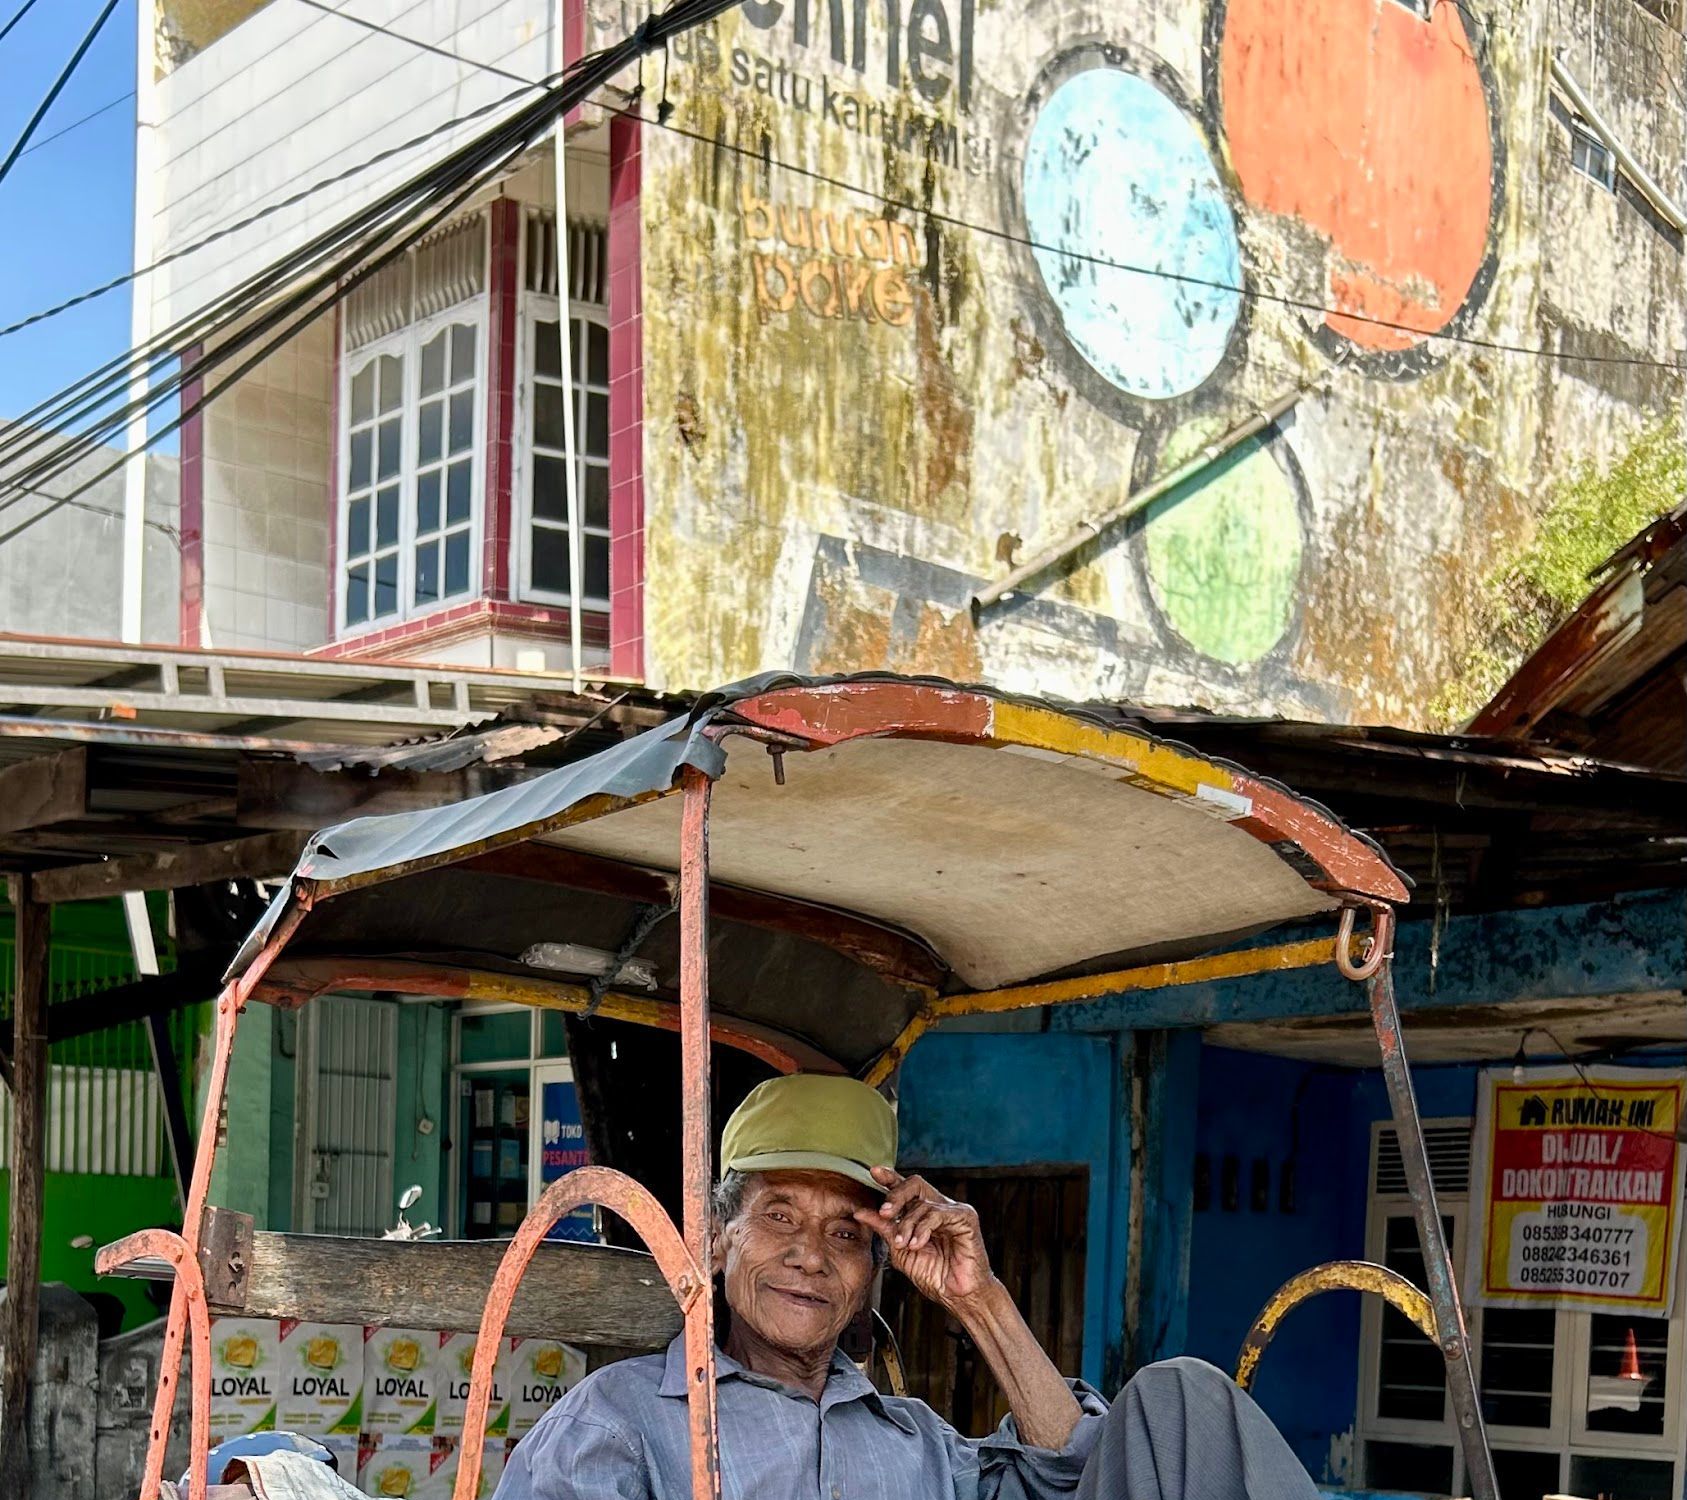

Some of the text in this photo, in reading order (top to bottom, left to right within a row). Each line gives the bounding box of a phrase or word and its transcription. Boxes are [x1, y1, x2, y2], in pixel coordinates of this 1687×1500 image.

[730, 47, 811, 114] satu
[742, 183, 920, 267] buruan
[752, 252, 914, 327] pake
[1551, 1097, 1656, 1127] RUMAH INI
[561, 1124, 582, 1139] TOKO
[1547, 1203, 1611, 1220] HUBUNGI
[212, 1376, 271, 1397] LOYAL
[293, 1377, 350, 1397] LOYAL
[376, 1378, 429, 1398] LOYAL
[449, 1382, 503, 1401] LOL
